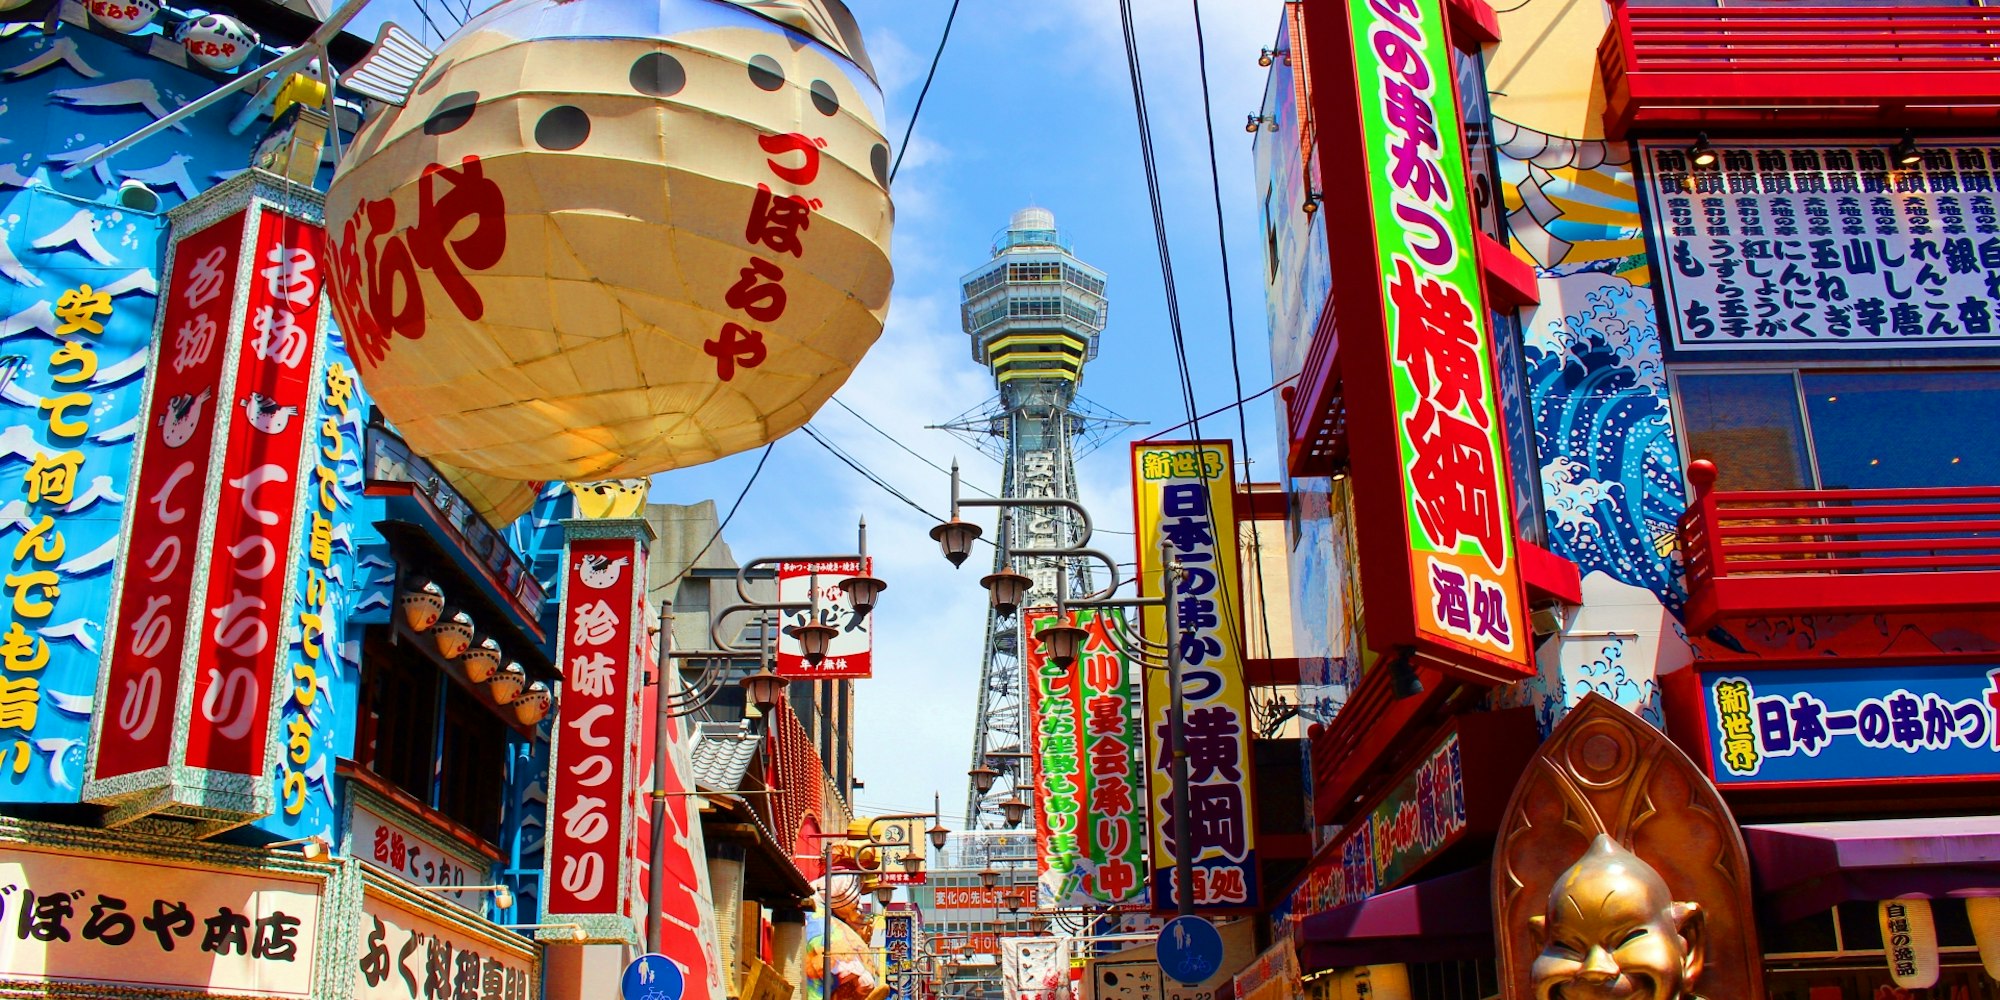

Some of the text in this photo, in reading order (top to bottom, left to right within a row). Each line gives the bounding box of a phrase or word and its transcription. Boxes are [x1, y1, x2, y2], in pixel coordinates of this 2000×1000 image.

[1655, 150, 1692, 194] 前頭
[1691, 152, 1726, 194] 頭
[1722, 150, 1760, 194] 前頭
[1756, 149, 1794, 194] 前頭
[1789, 149, 1828, 194] 前頭
[1892, 150, 1927, 193] 頭
[1955, 148, 1993, 192] 前頭
[704, 133, 827, 382] づぼらや
[1673, 239, 1715, 338] もち
[1708, 239, 1753, 338] うずら玉子
[1738, 239, 1788, 338] 紅しょうが
[1773, 240, 1817, 338] にんにく
[1808, 238, 1853, 338] 玉ねぎ
[1823, 149, 1861, 193] 前頭
[1842, 238, 1888, 337] 山芋
[1856, 149, 1893, 193] 前頭
[1876, 238, 1923, 337] しし唐
[1909, 237, 1959, 335] れんこん
[1922, 148, 1960, 192] 前頭
[1942, 237, 1991, 335] 銀杏
[1389, 258, 1505, 570] 横綱
[1144, 451, 1223, 480] 新世界
[1433, 563, 1511, 645] 酒処
[1033, 617, 1083, 902] としたお座敷もあります!!
[1083, 613, 1133, 898] 大小宴会承り中
[1717, 680, 1758, 772] 新世界
[1757, 694, 1986, 753] 日本一の串かつ
[1157, 707, 1245, 862] 横綱
[1173, 870, 1243, 899] 酒処
